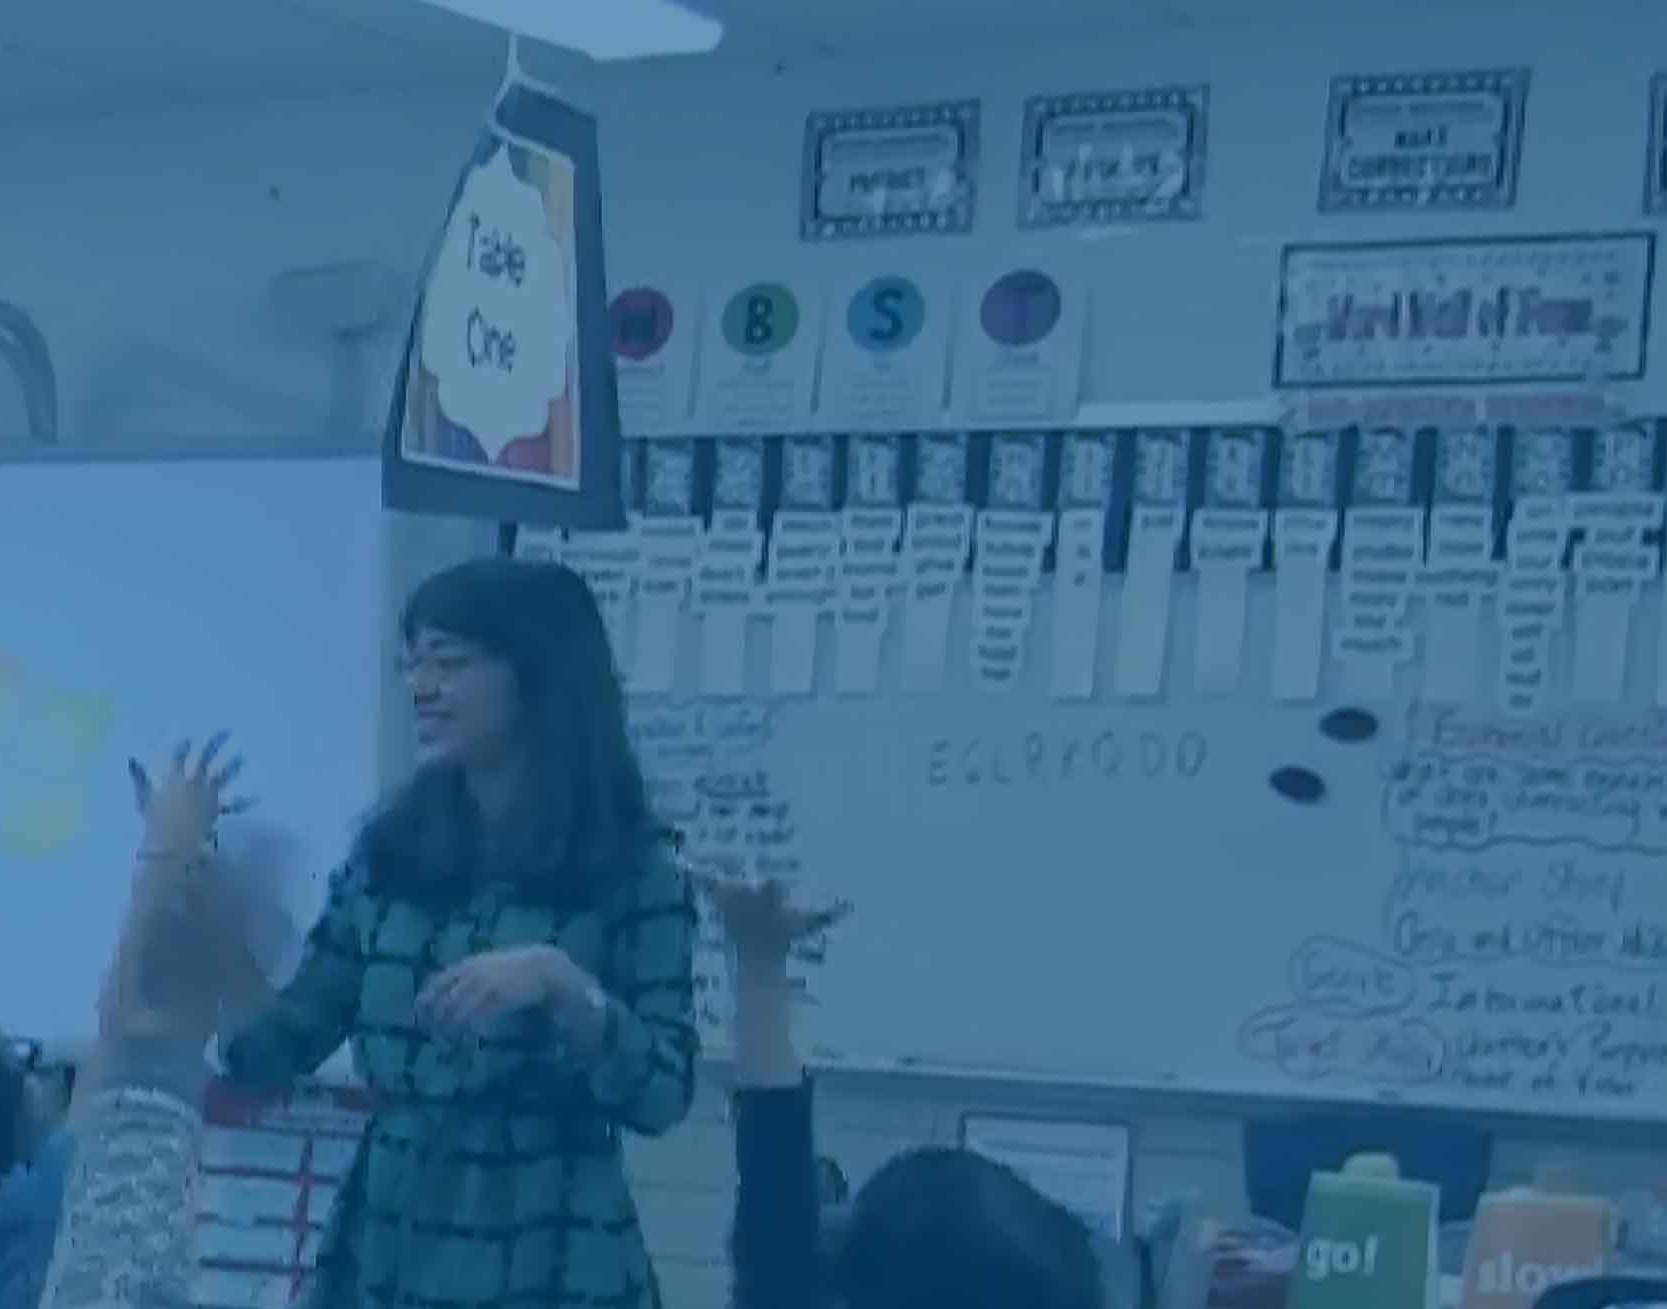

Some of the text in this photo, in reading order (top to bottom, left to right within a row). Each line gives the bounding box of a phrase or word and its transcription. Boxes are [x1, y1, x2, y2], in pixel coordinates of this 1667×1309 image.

[466, 211, 525, 288] Table
[467, 305, 516, 374] One
[744, 297, 774, 345] B
[869, 288, 904, 342] S
[1306, 1235, 1379, 1281] go!
